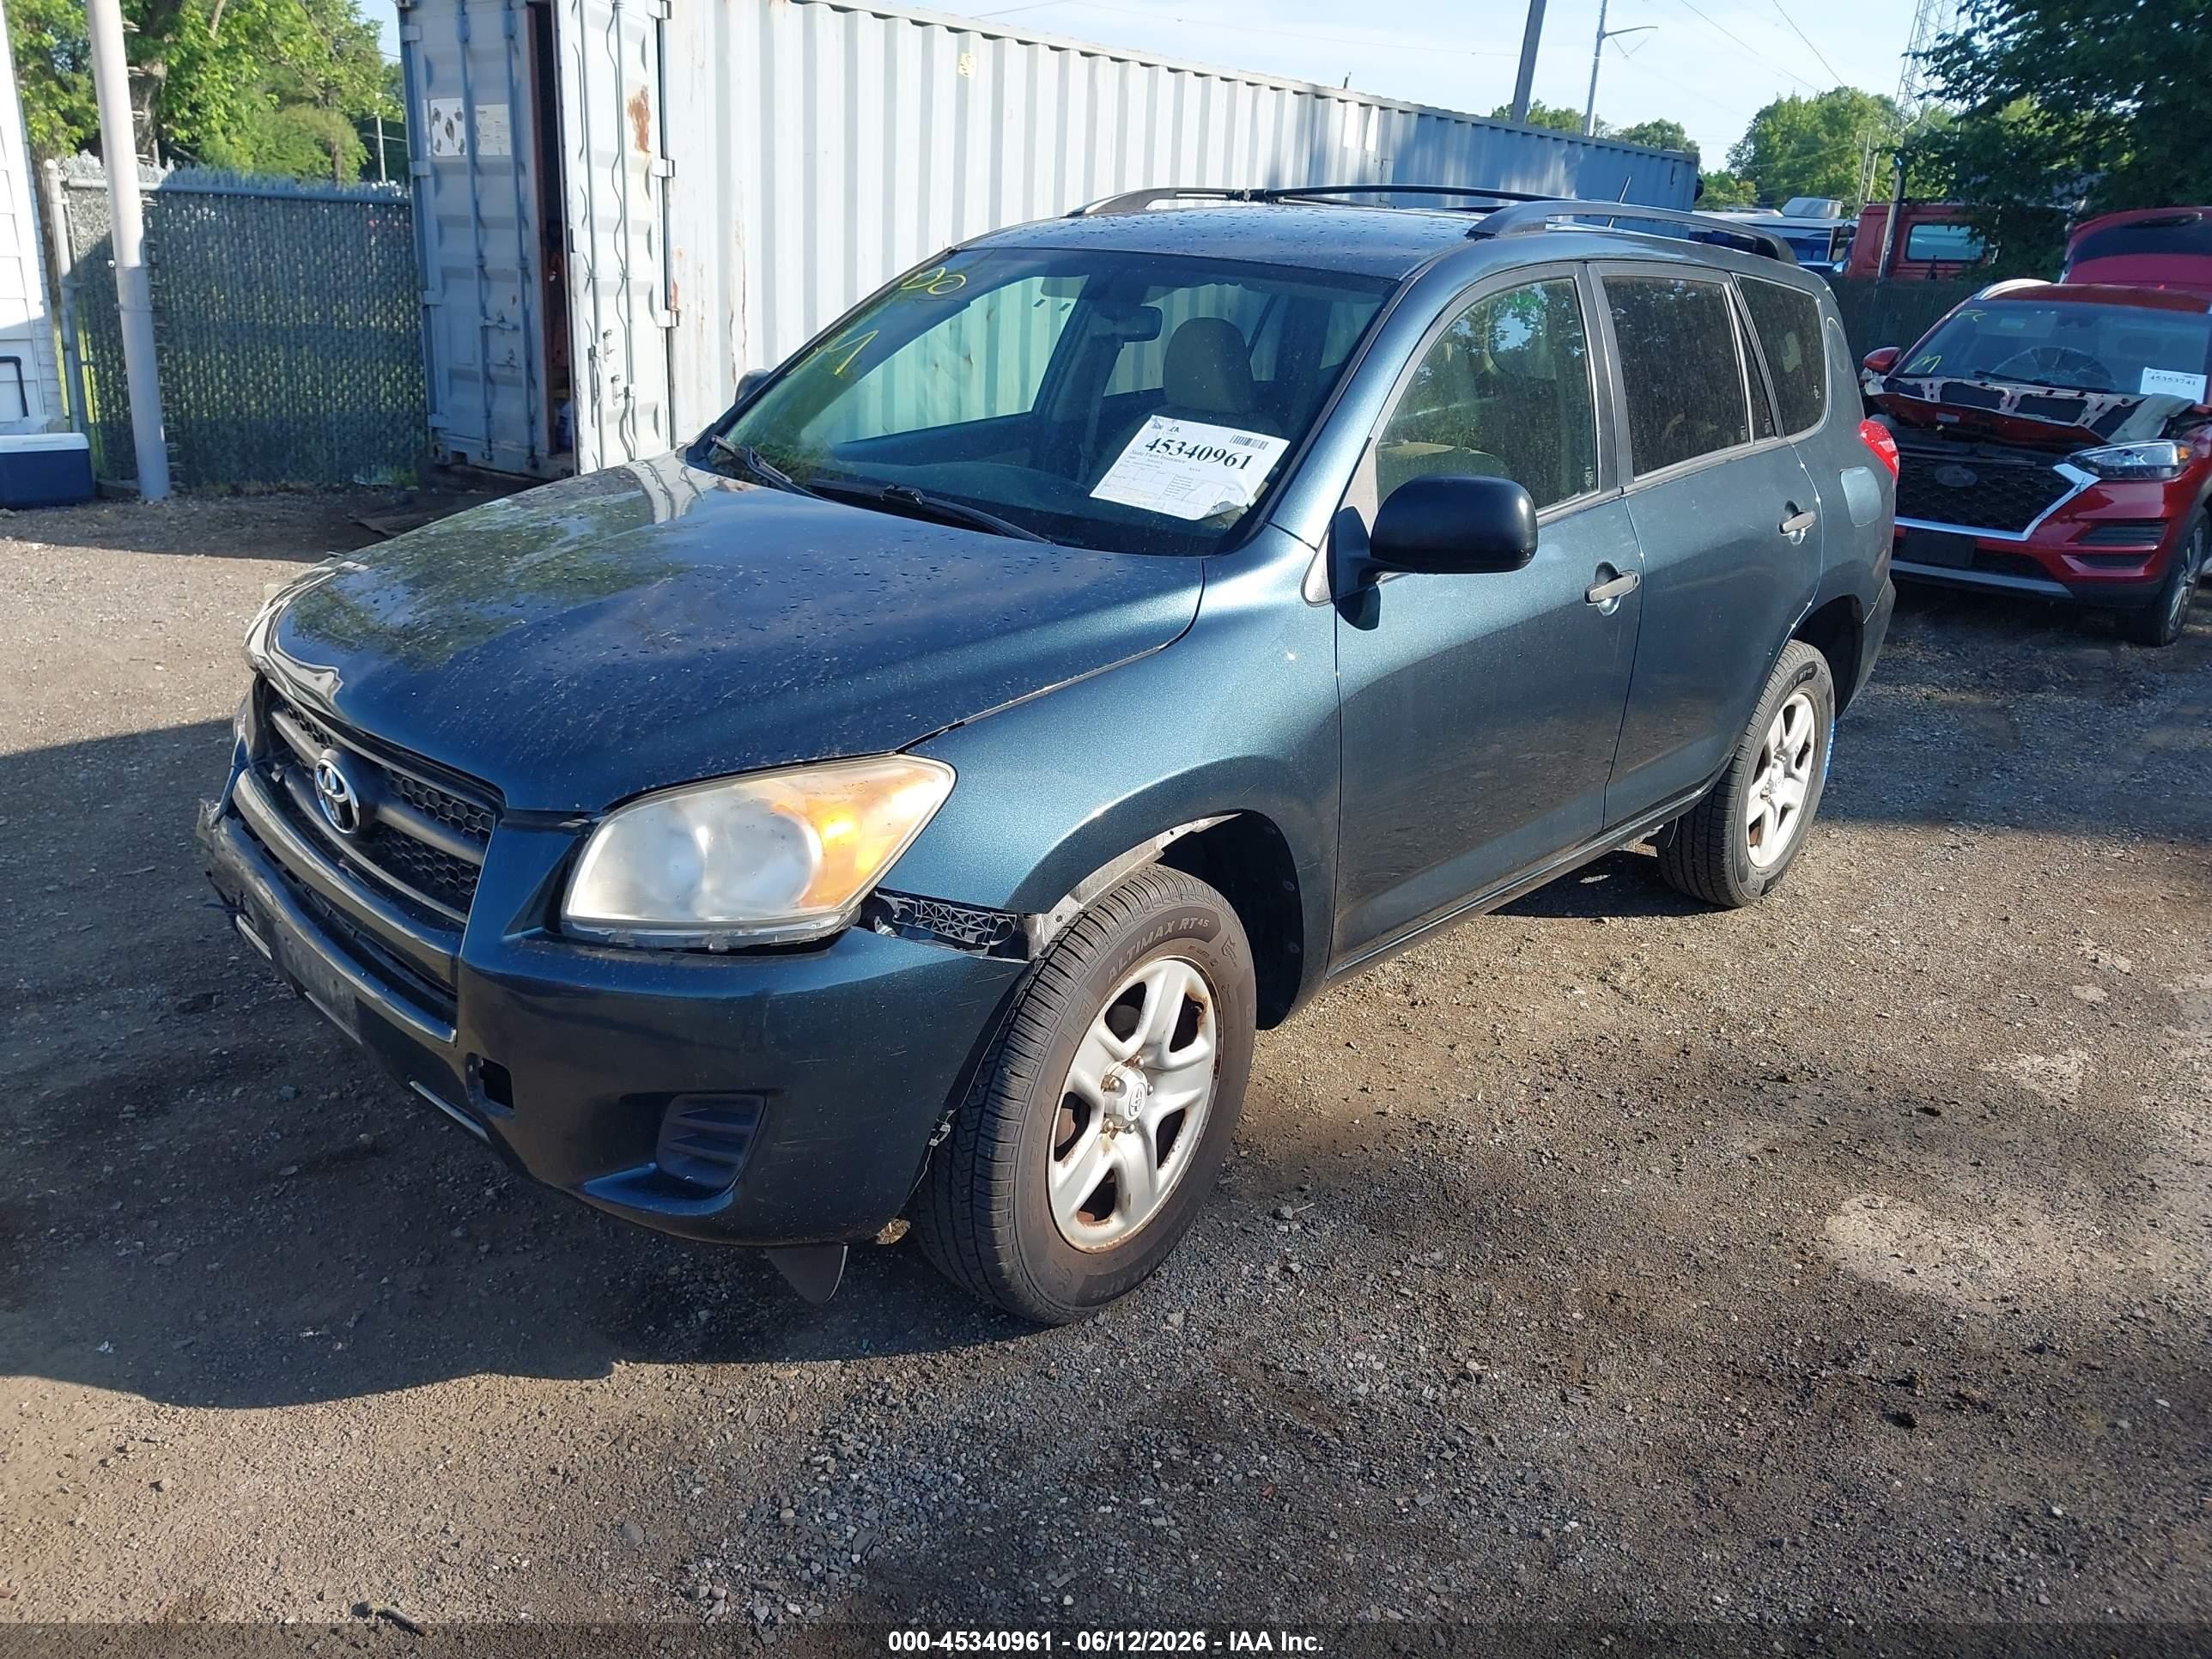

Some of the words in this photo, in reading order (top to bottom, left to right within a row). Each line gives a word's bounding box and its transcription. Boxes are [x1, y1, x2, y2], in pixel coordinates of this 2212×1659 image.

[1145, 437, 1253, 471] 45340961
[1108, 920, 1176, 985] ALTIMAX
[1178, 916, 1211, 932] RT45
